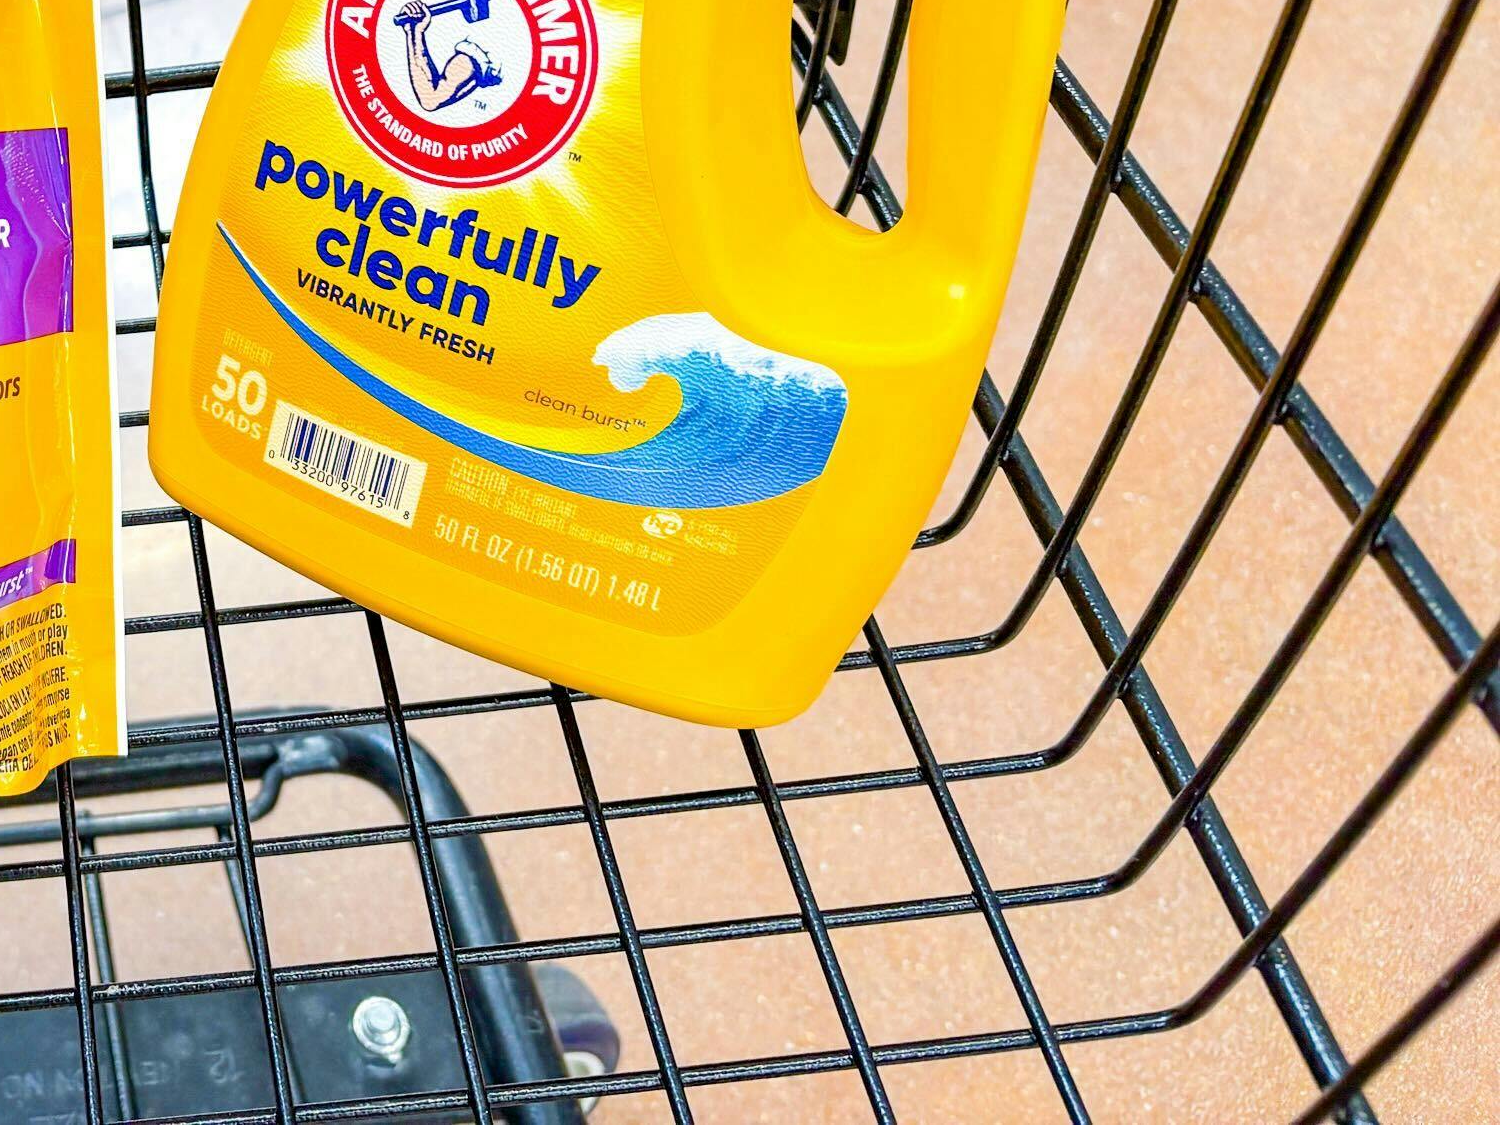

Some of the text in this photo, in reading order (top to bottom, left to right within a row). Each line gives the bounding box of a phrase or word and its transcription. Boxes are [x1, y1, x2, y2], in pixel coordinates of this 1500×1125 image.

[351, 62, 530, 162] THE STANDARD OF PURITY
[253, 138, 603, 309] powerfully
[315, 220, 492, 327] clean
[297, 267, 496, 366] VIBRANTLY FRESH
[211, 353, 268, 416] 50
[523, 386, 578, 418] clean
[201, 394, 262, 441] LOADS
[268, 449, 411, 520] 0 33200 97615 8
[433, 512, 460, 544] 50
[460, 523, 480, 553] FL
[485, 533, 514, 564] OZ
[515, 544, 566, 582] (1.56
[607, 573, 649, 607] 1.48
[650, 586, 661, 612] L
[5, 620, 15, 639] OR
[15, 602, 67, 634] SWALLOWED.
[37, 628, 46, 642] or
[47, 623, 69, 645] play
[0, 657, 25, 686] REACH
[23, 652, 33, 671] OF
[11, 691, 22, 711] EN
